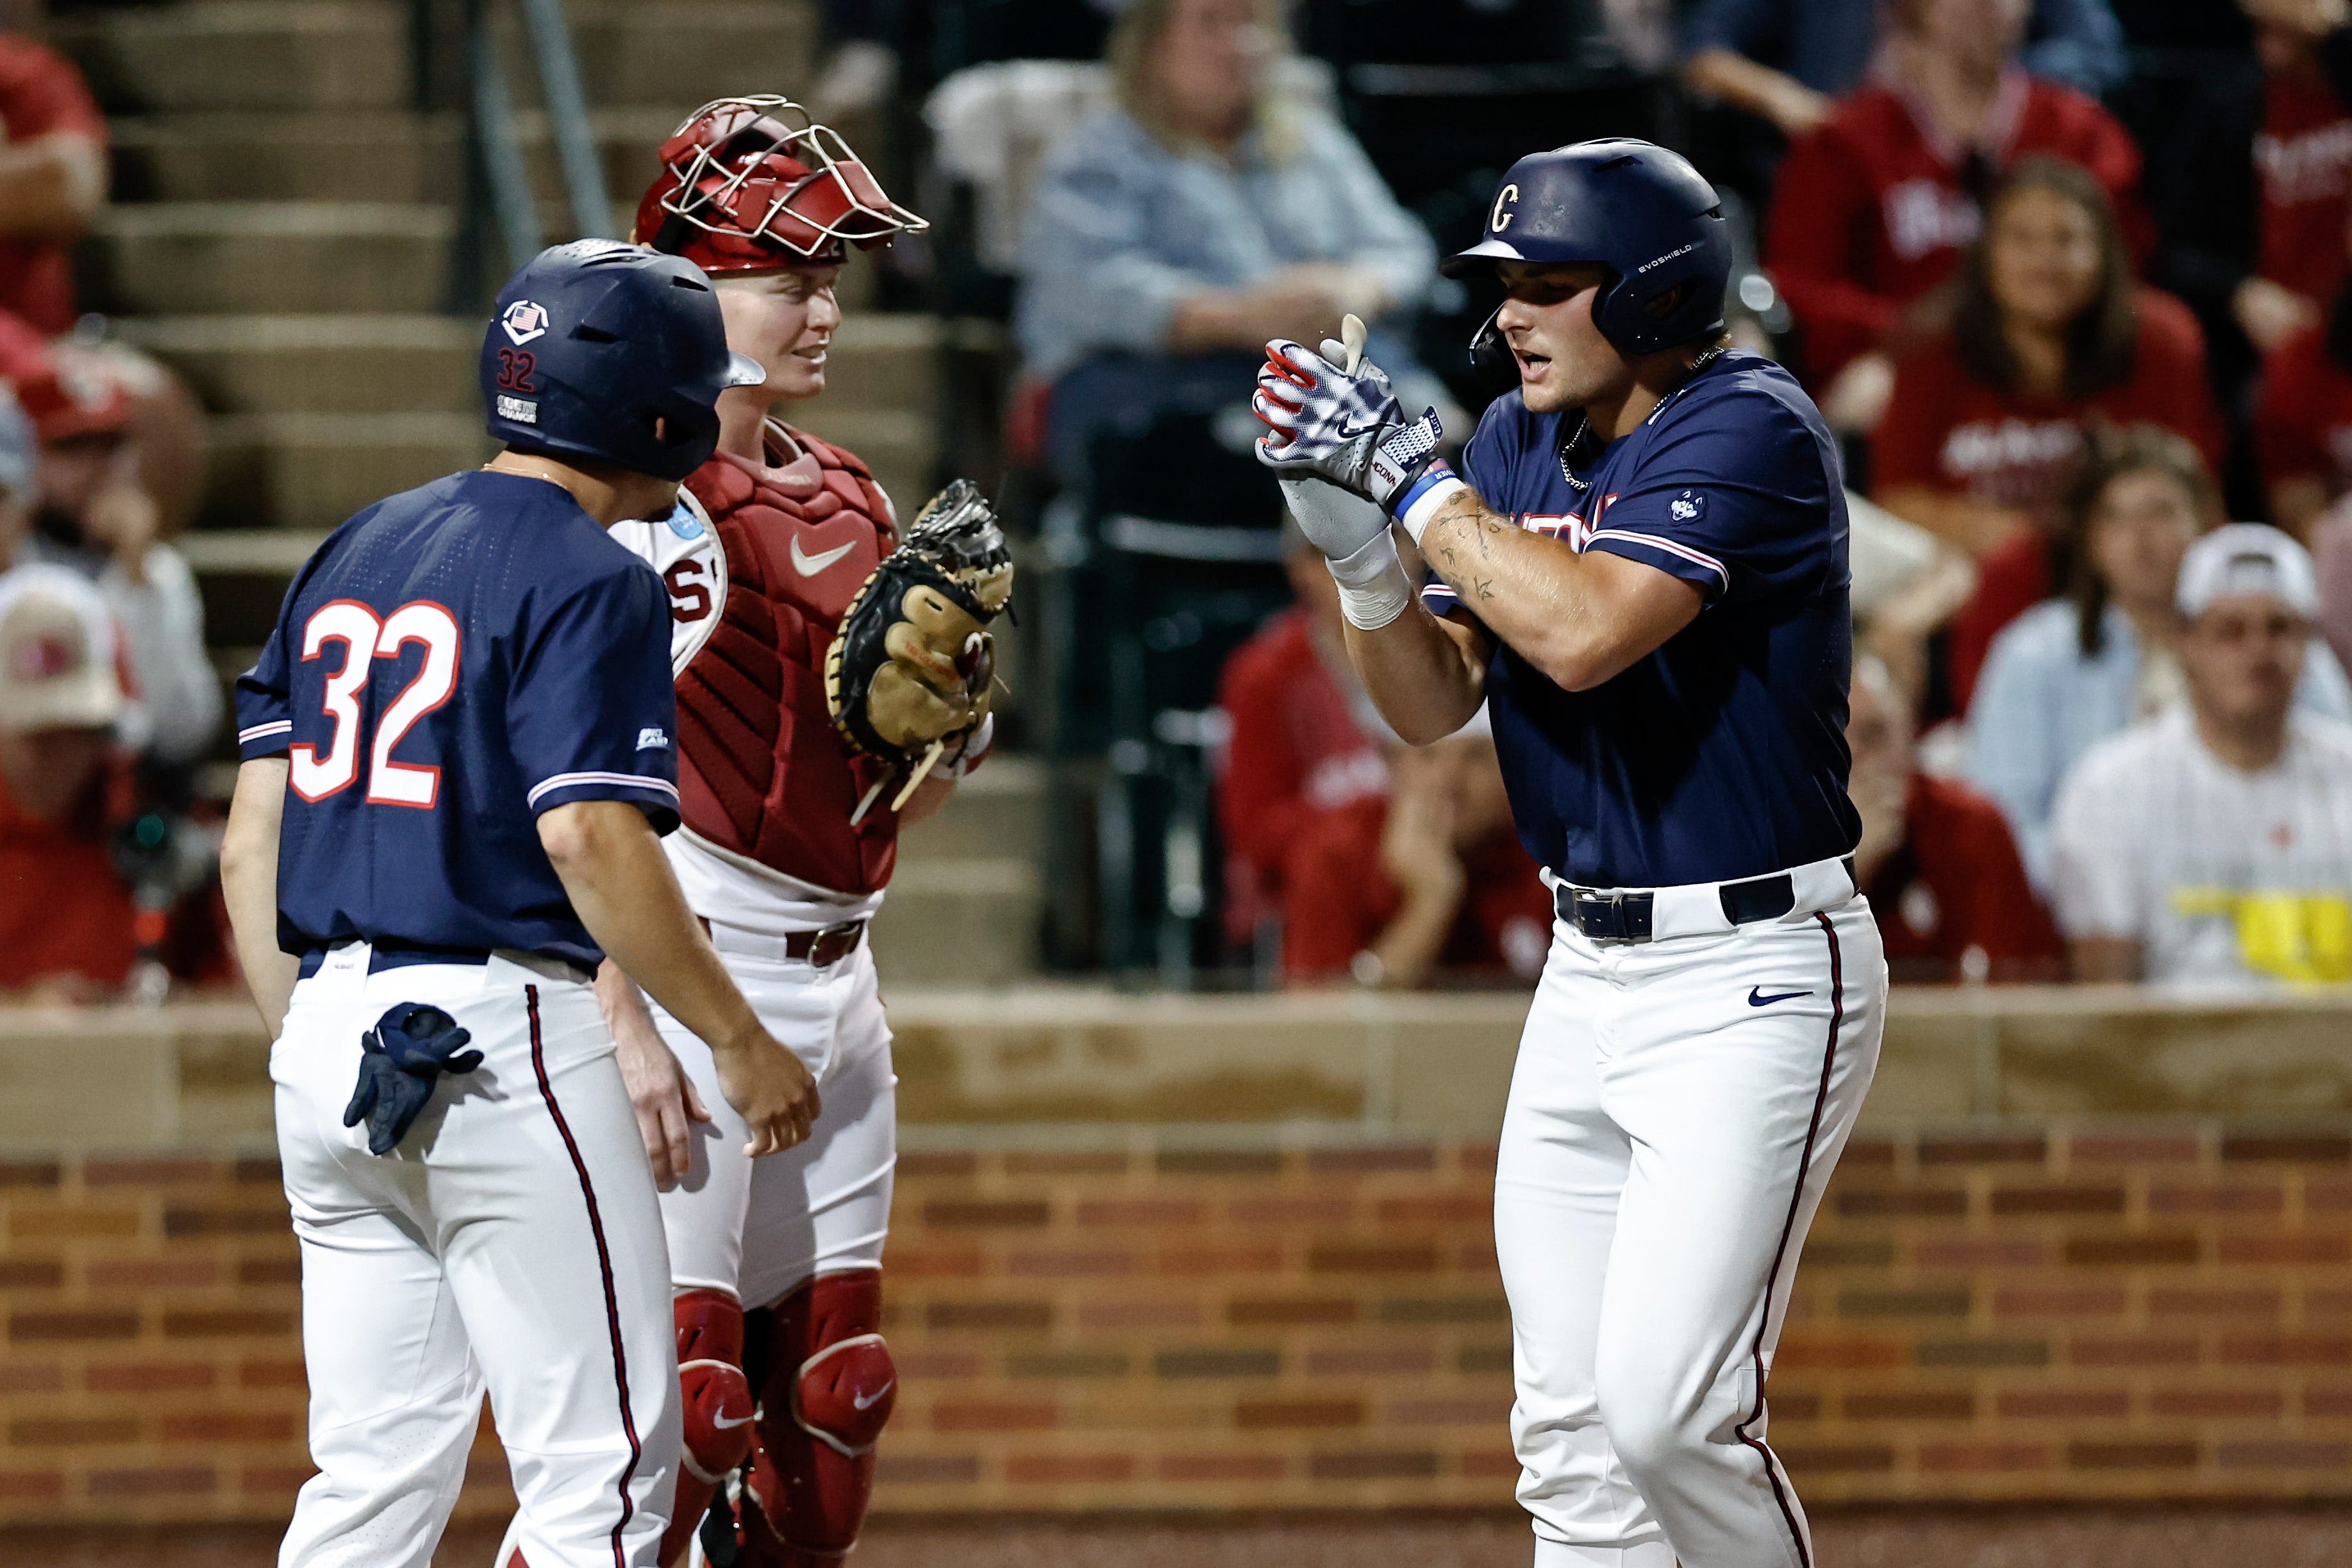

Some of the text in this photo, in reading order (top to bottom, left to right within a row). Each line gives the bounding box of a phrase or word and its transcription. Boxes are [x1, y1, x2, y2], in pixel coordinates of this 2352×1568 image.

[1492, 184, 1519, 232] C
[1638, 244, 1692, 273] EVOSHIELD
[497, 347, 536, 392] 32
[1429, 412, 1441, 435] ELITE
[663, 558, 717, 623] S
[289, 598, 462, 810] 32
